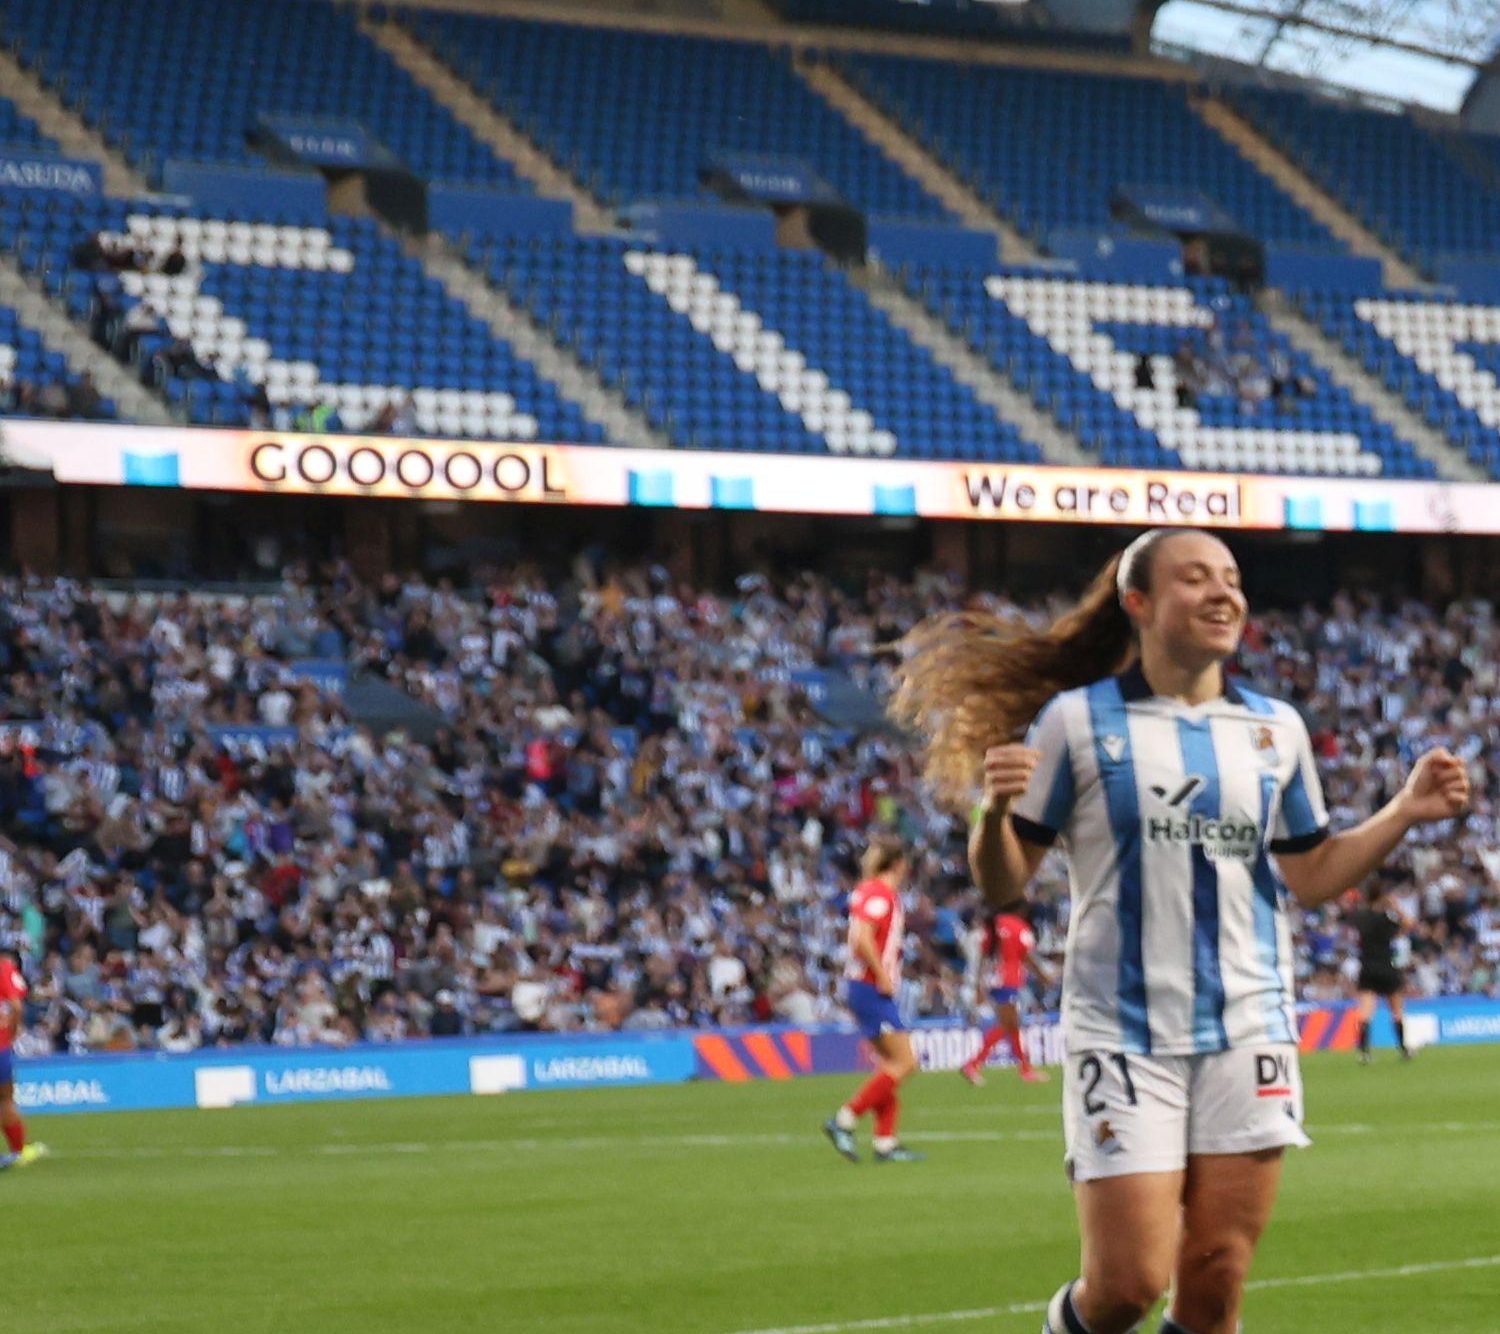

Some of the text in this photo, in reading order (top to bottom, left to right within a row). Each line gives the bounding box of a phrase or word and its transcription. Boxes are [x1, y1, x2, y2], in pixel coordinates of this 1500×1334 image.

[250, 443, 566, 497] GOOOOOL
[966, 474, 1242, 518] We are Real
[265, 1067, 391, 1095] LARZABAL
[534, 1054, 649, 1082] LARZABAL
[1077, 1052, 1138, 1116] 21
[14, 1080, 108, 1108] ZABAL
